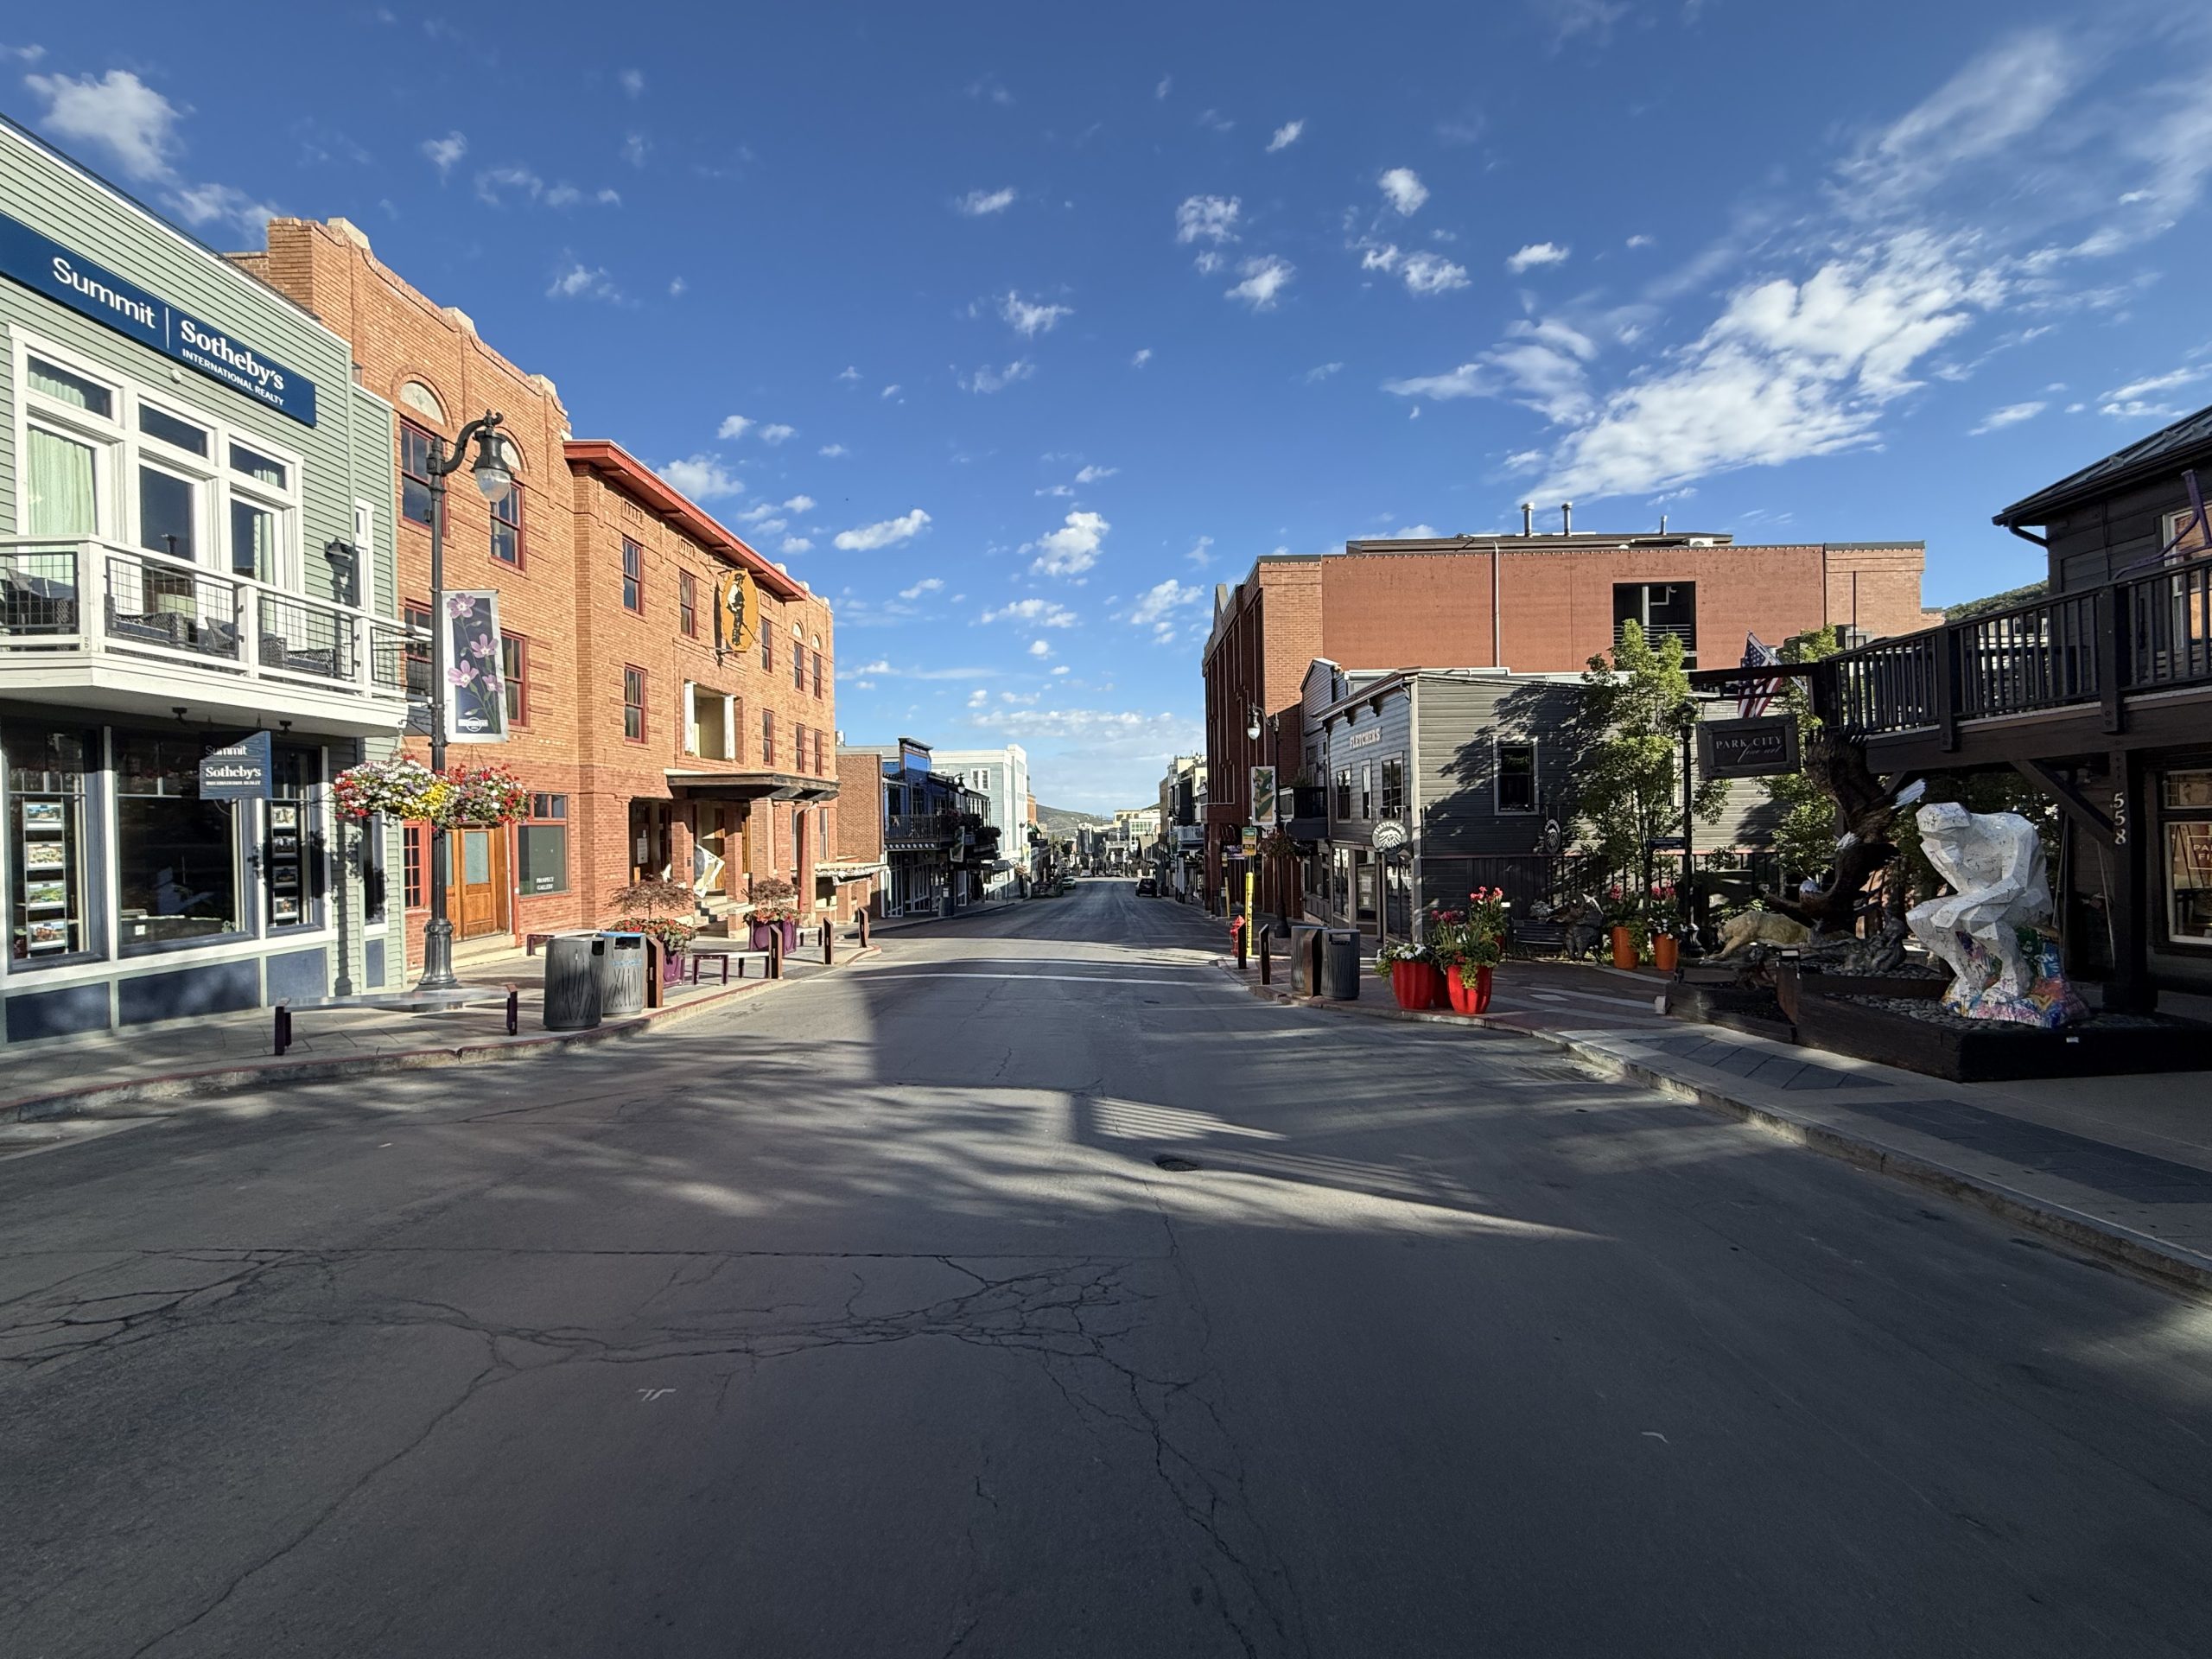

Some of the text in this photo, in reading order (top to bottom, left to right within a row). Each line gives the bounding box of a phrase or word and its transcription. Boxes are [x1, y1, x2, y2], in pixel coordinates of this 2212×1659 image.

[53, 257, 156, 329] Summit
[181, 320, 284, 391] Sotheby's
[182, 348, 284, 406] INTERNATIONAL REALTY
[206, 745, 247, 755] Summit
[1716, 736, 1781, 749] PARK CITY
[206, 766, 261, 779] Sotheby's
[2113, 791, 2126, 845] 558
